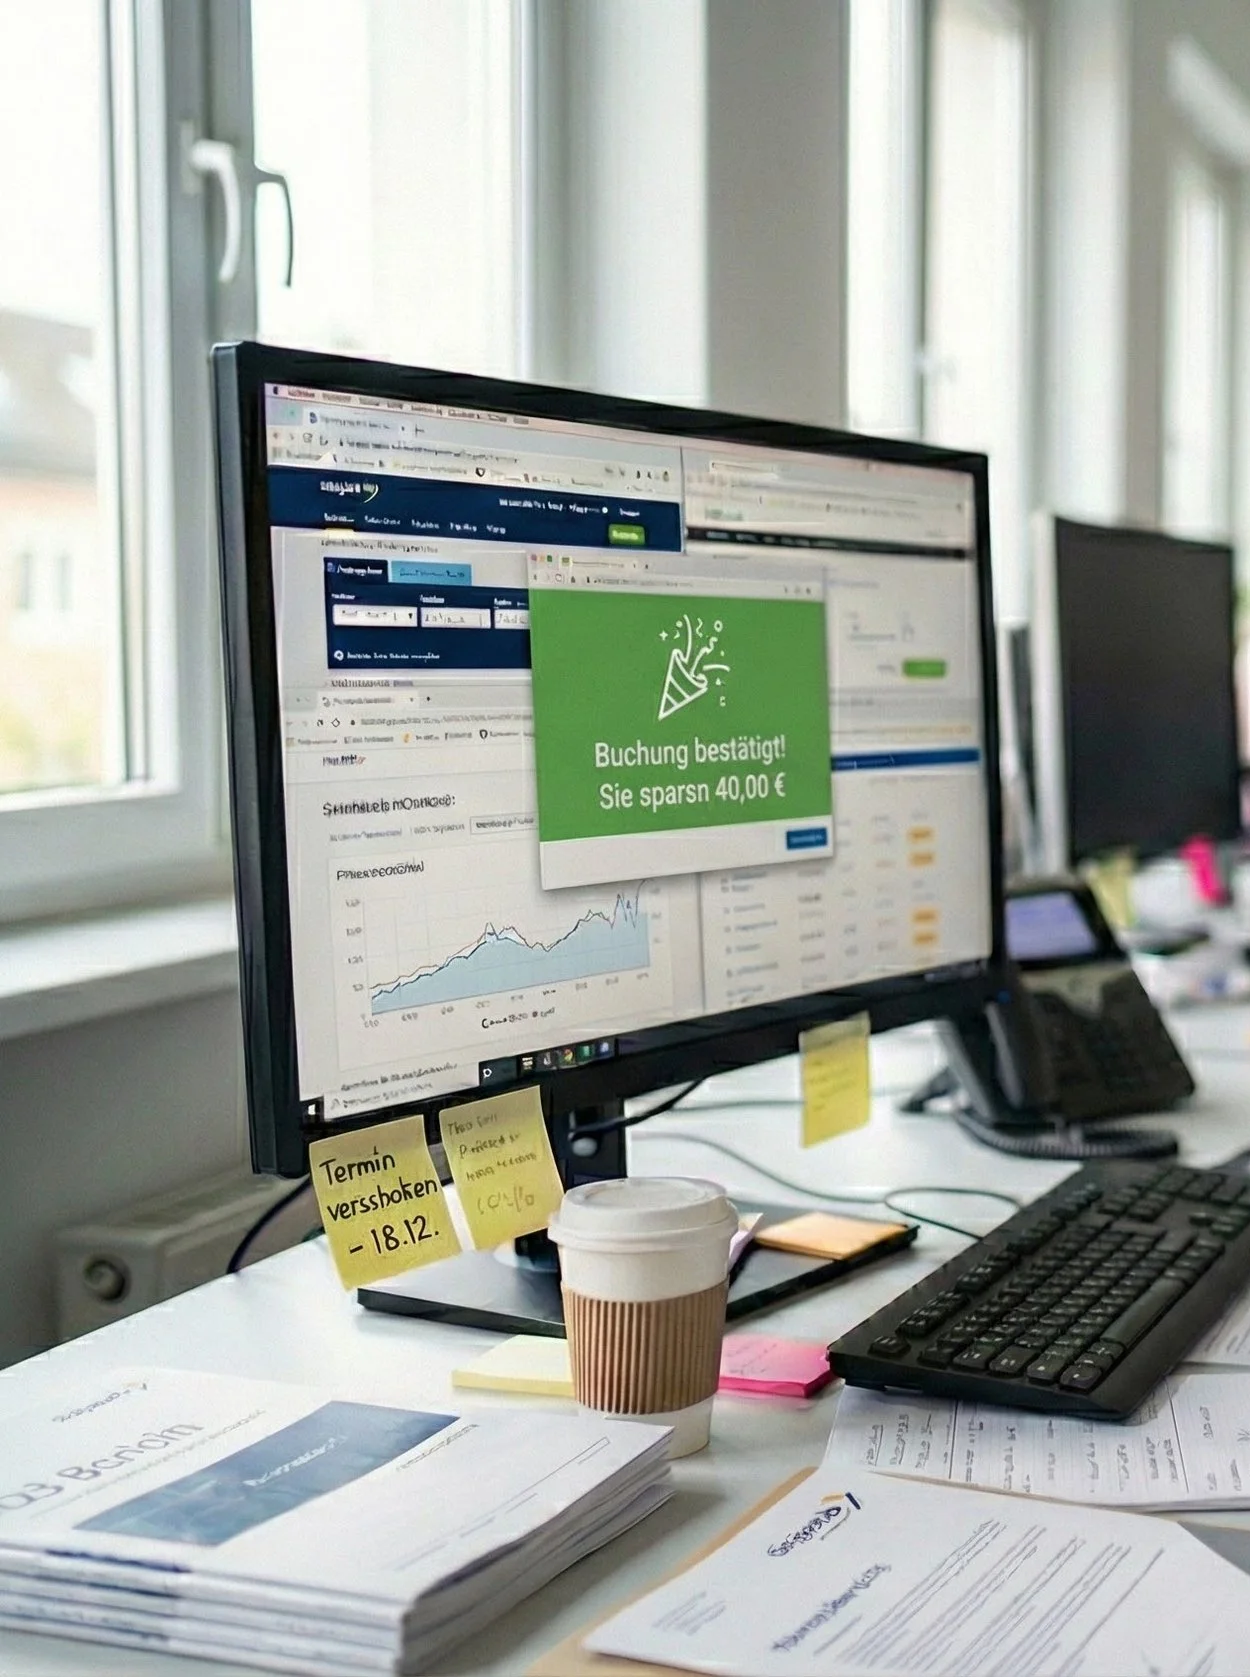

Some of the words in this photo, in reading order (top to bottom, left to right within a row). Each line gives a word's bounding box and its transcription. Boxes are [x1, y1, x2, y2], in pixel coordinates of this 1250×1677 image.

[595, 739, 688, 770] Buchung
[694, 734, 786, 765] bestätigt!
[599, 782, 633, 810] Sie
[715, 773, 769, 805] 40,00
[774, 771, 786, 797] €
[319, 1145, 396, 1186] Termin
